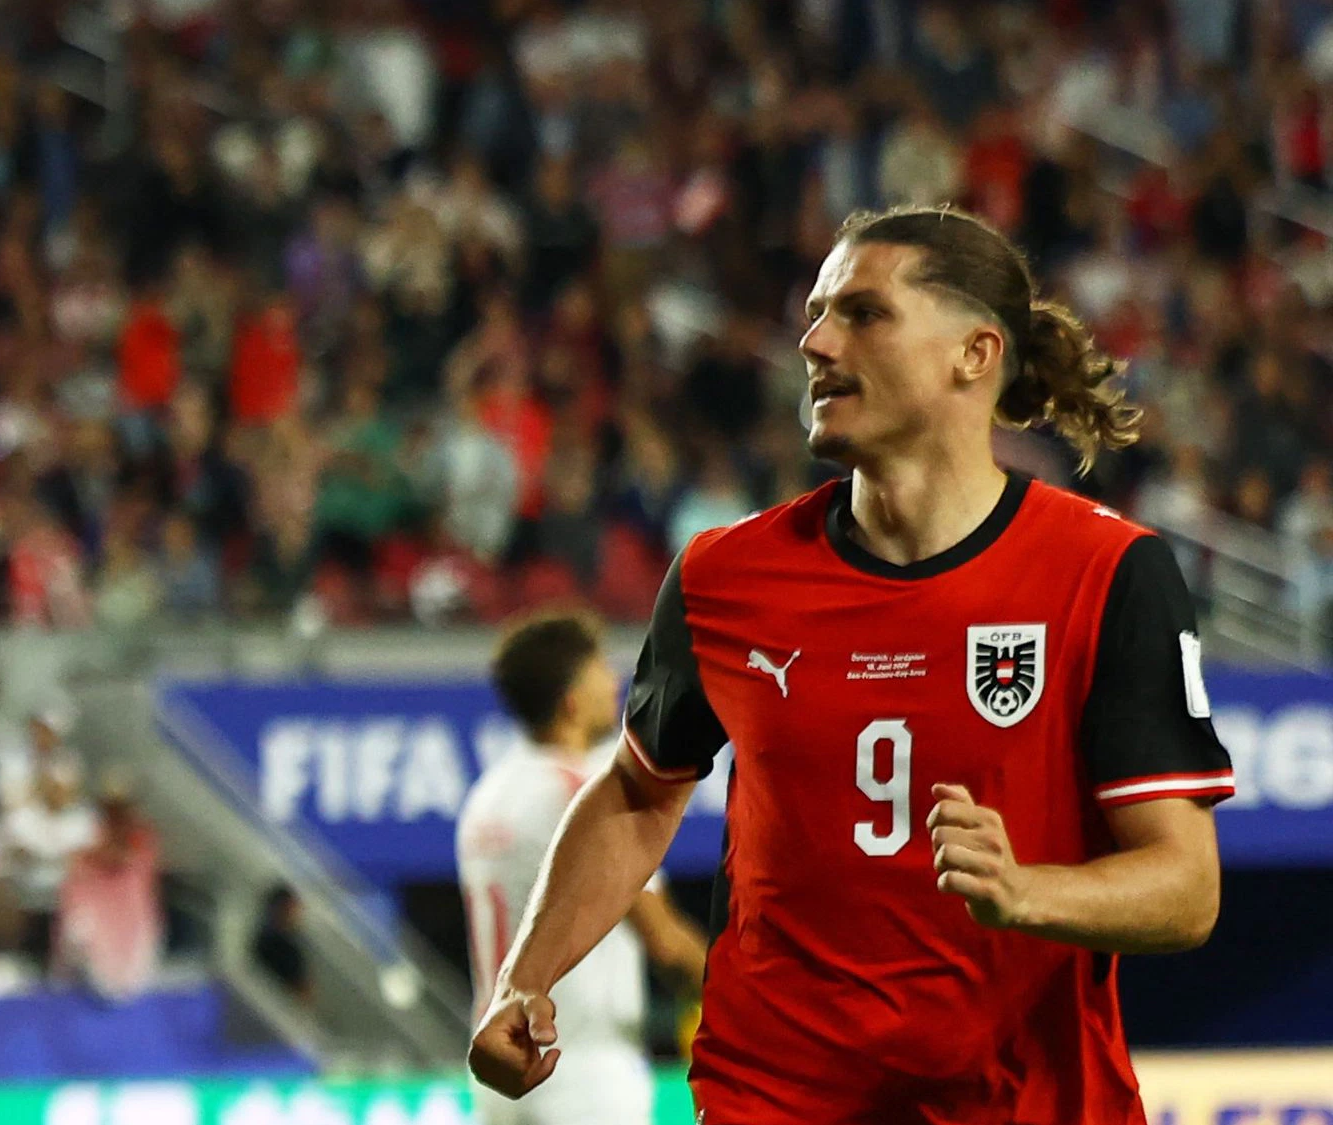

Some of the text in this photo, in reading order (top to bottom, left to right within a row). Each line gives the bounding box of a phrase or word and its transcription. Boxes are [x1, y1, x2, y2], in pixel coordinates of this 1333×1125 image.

[990, 632, 1022, 642] ÖFB
[257, 714, 470, 824] FIFA
[854, 719, 912, 857] 9
